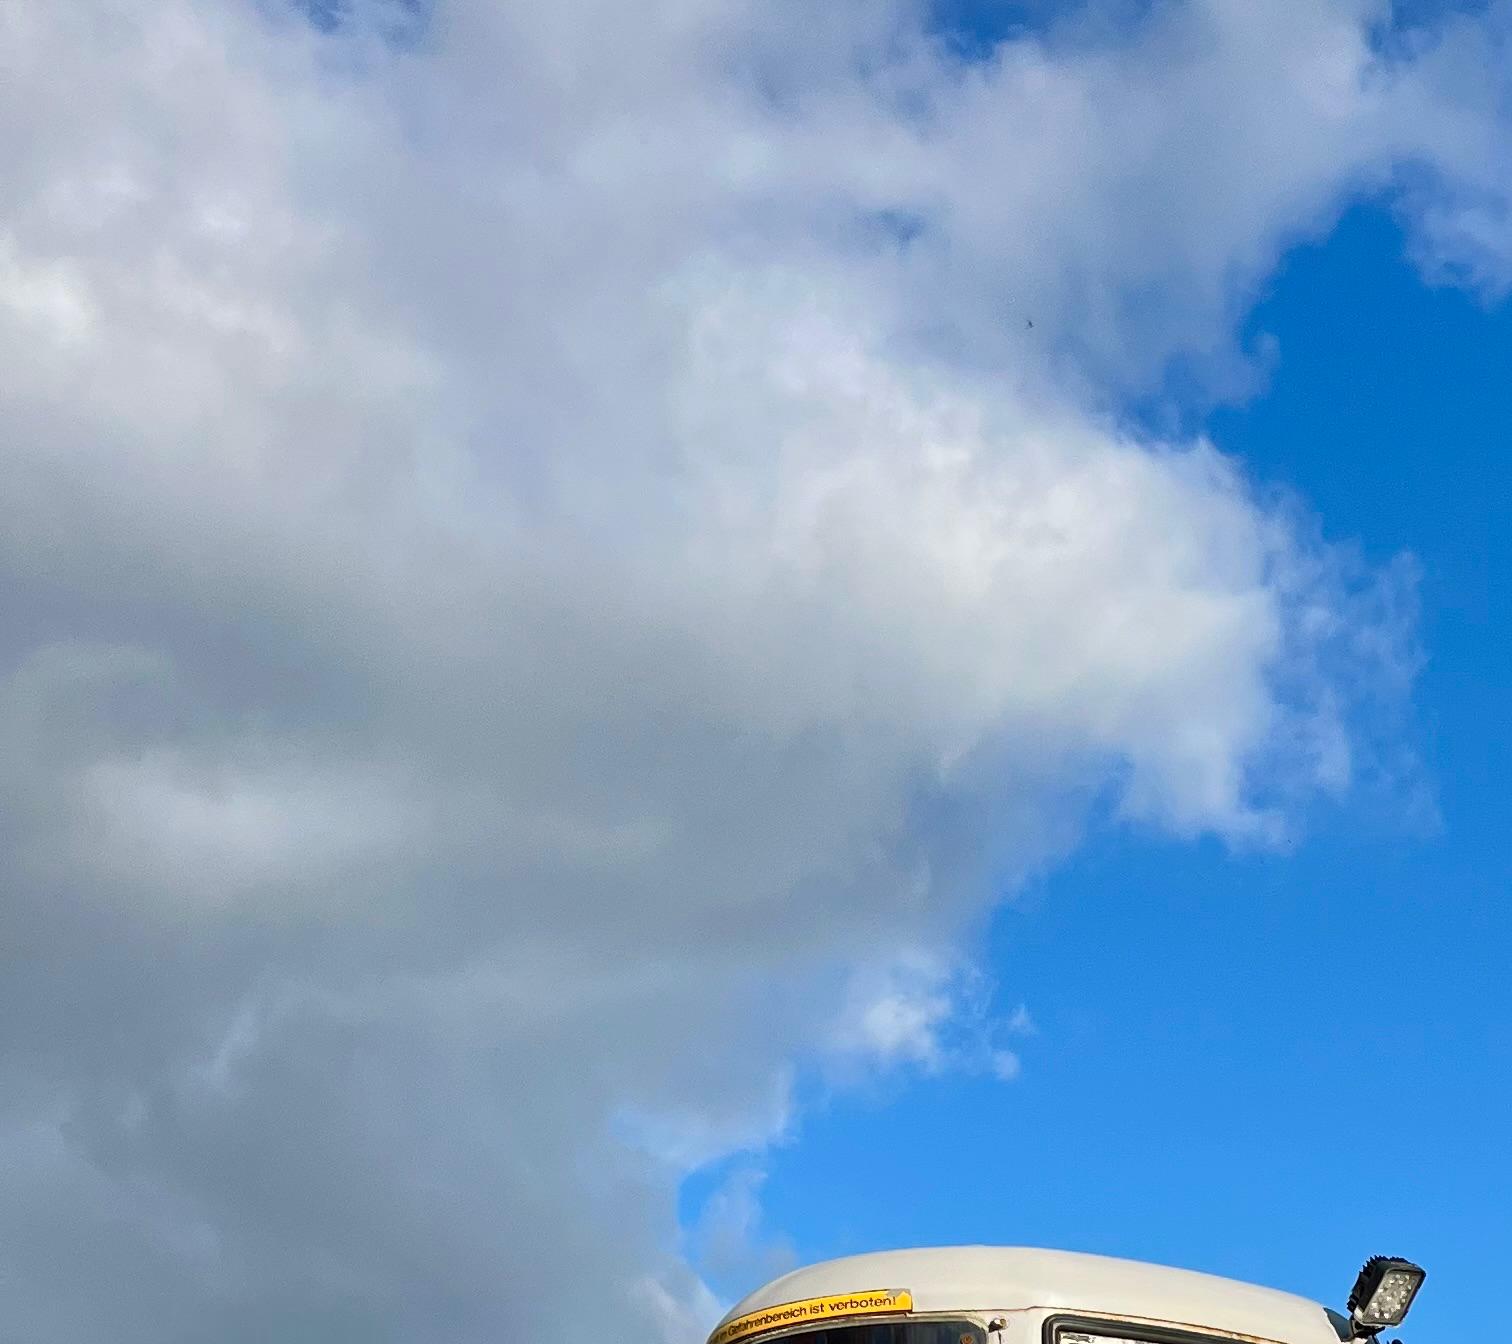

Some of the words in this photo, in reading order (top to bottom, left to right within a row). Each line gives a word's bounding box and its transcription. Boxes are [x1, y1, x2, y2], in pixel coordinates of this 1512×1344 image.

[728, 1307, 806, 1336] Gefahrenbereich
[810, 1304, 824, 1314] ist
[829, 1296, 896, 1311] verboten!
